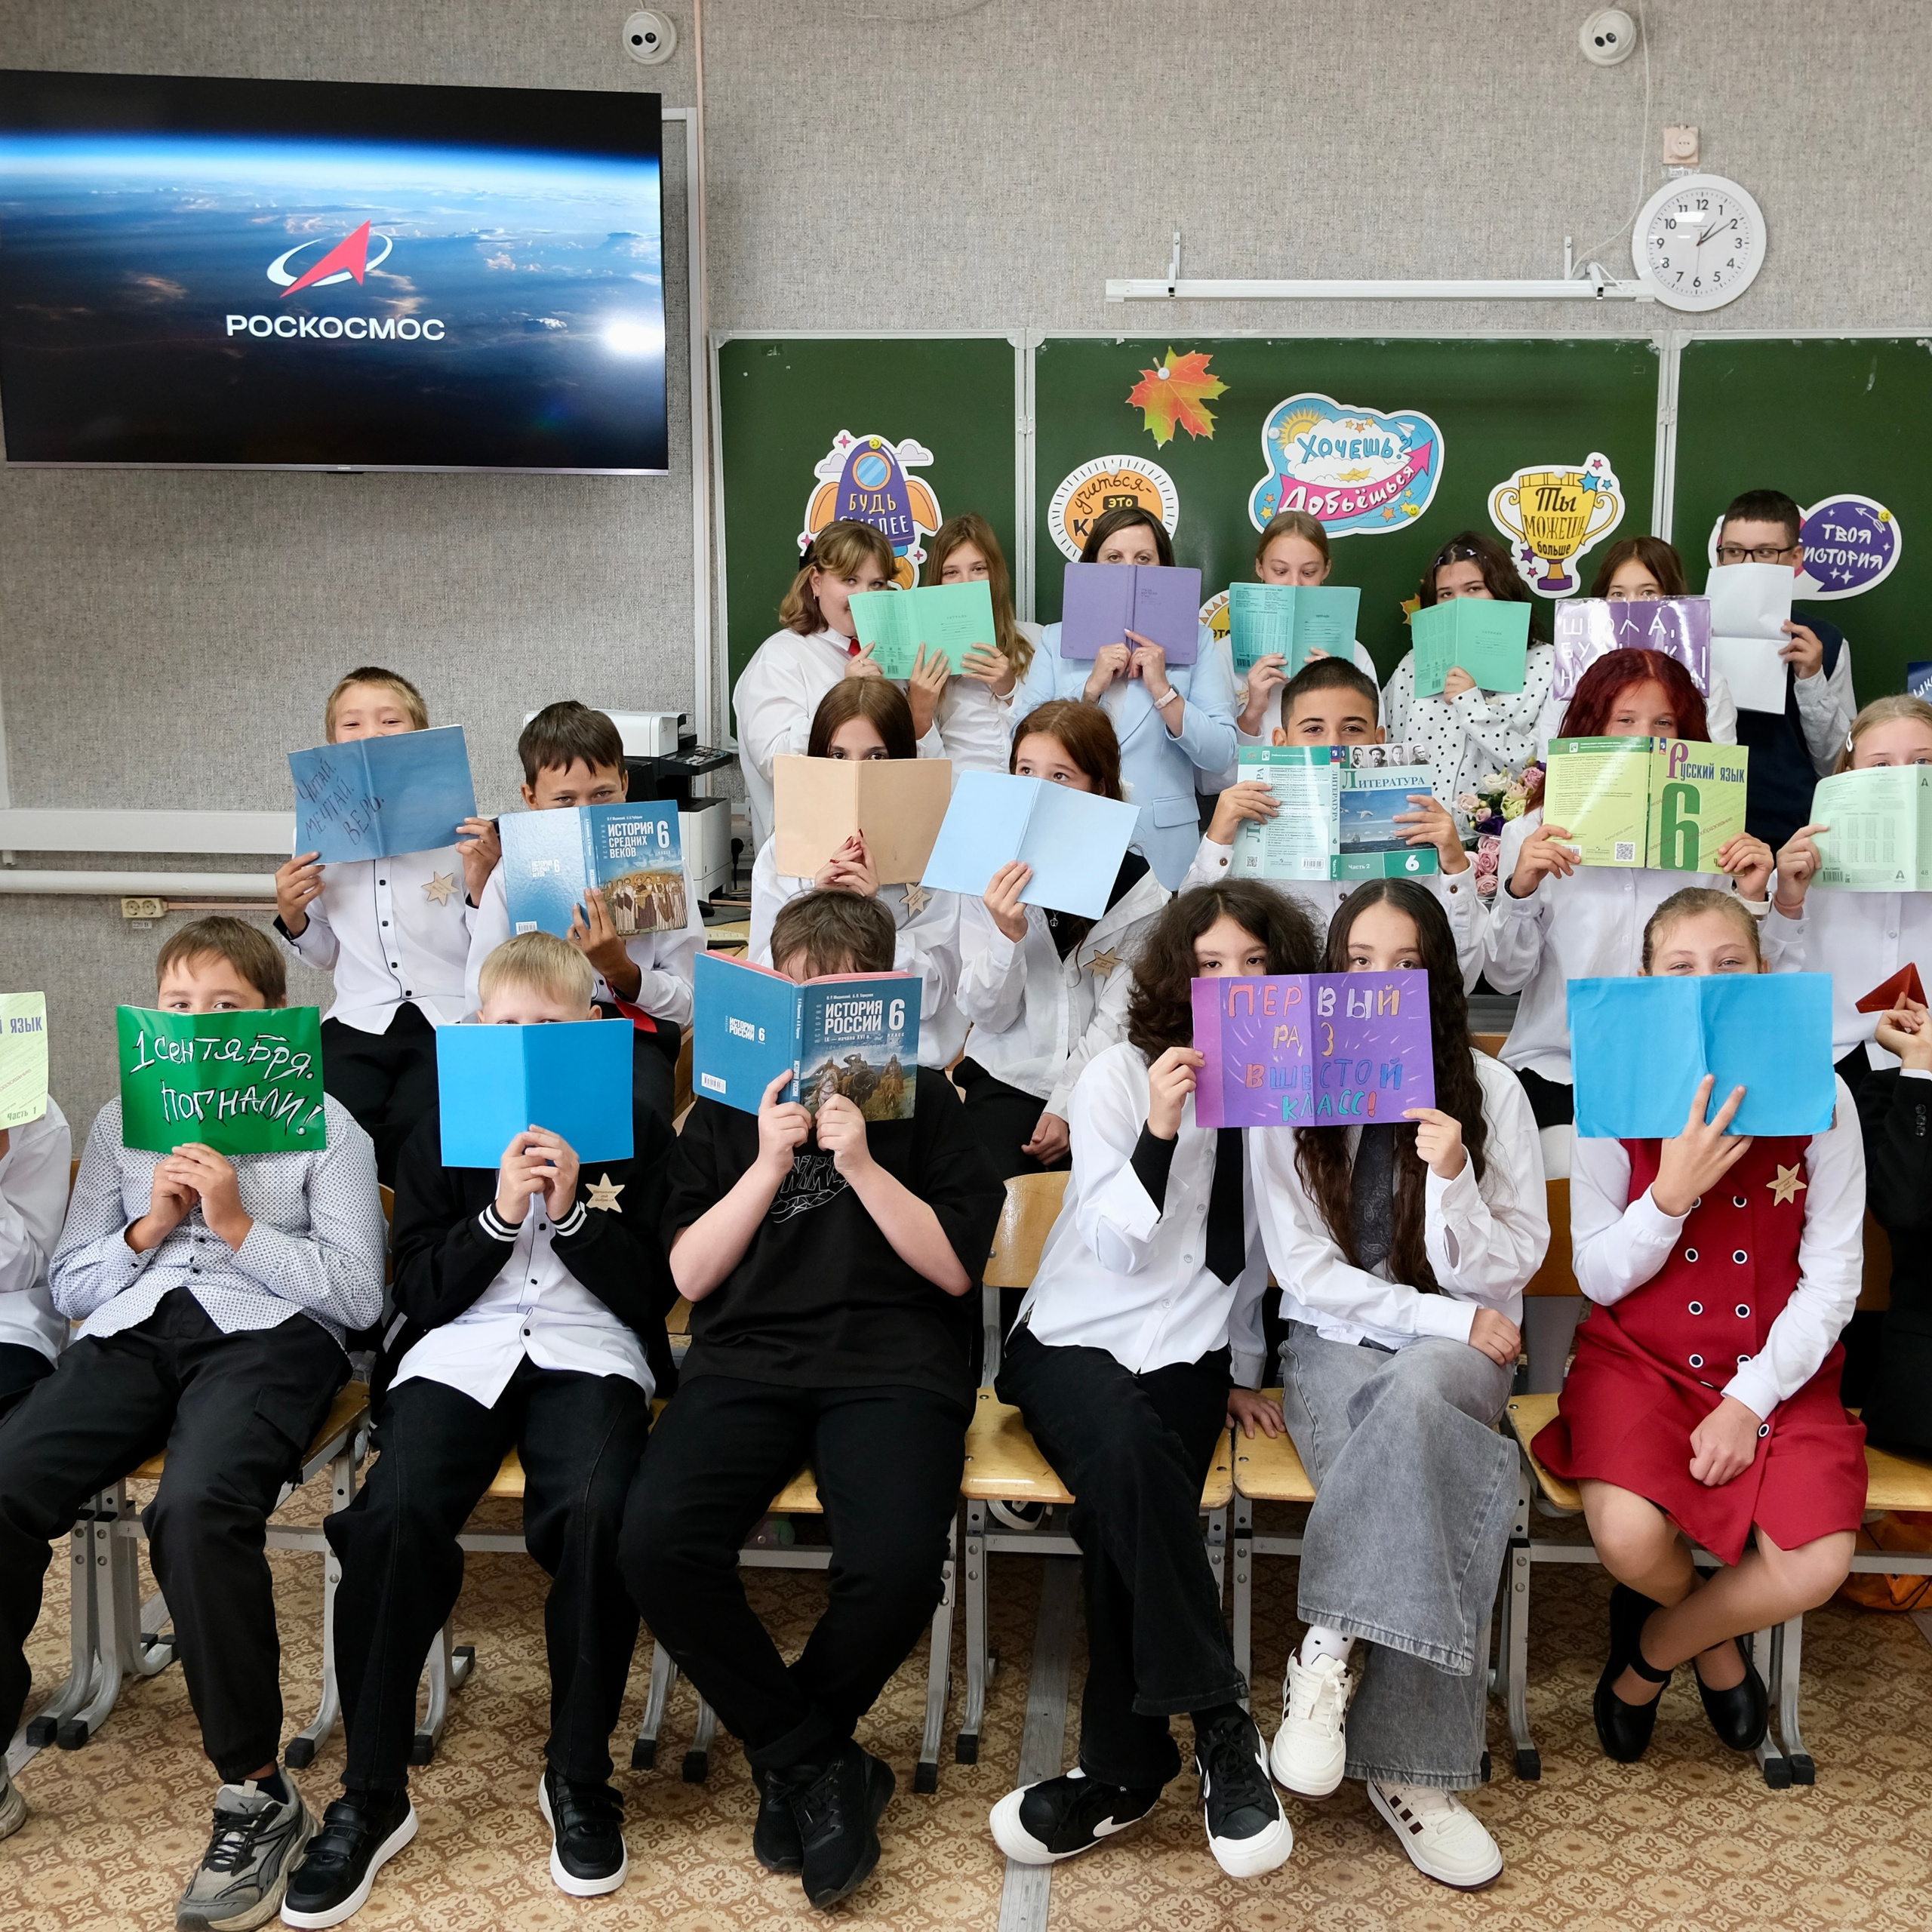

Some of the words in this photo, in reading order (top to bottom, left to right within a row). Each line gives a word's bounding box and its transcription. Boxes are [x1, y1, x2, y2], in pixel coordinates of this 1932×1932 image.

[1678, 205, 1687, 213] 11
[1697, 199, 1709, 211] 12
[1718, 205, 1723, 215] 1
[1664, 218, 1676, 229] 10
[1730, 219, 1738, 229] 2
[1657, 238, 1665, 248] 9
[1734, 238, 1743, 248] 3
[1662, 257, 1669, 268] 8
[1727, 258, 1735, 268] 4
[1676, 272, 1684, 282] 7
[1693, 276, 1701, 288] 6
[1713, 272, 1721, 282] 5
[226, 314, 445, 341] РОСКОСМОС
[1297, 434, 1413, 464] ХОЧЕШЬ?
[1278, 465, 1416, 515] Добьёшься
[848, 493, 898, 515] БУДЬ
[1107, 497, 1134, 509] ЭТО
[1535, 487, 1577, 512] Ты
[839, 515, 910, 536] ЛЕЕ
[1523, 514, 1586, 540] МОЖЕШЬ
[1821, 523, 1872, 545] ТВОЯ
[1537, 540, 1571, 556] больше
[1803, 546, 1884, 571] ИСТОРИЯ
[1666, 742, 1715, 782] Русский
[1720, 767, 1745, 783] язык
[297, 758, 337, 804] ЧИТАЙ.
[1342, 770, 1426, 789] ЛИТЕРАТУРА
[305, 778, 355, 841] МЕЧТАЙ.
[608, 821, 654, 837] ИСТОРИЯ
[657, 820, 670, 849] 6
[1660, 782, 1701, 872] 6
[608, 835, 648, 848] СРЕДНИХ
[609, 847, 637, 859] ВЕКОВ
[553, 859, 560, 873] 6
[1405, 854, 1420, 872] 6
[826, 999, 883, 1019] ИСТОРИЯ
[1227, 983, 1401, 1021] ПЕРВЫЙ
[888, 998, 906, 1031] 6
[10, 1016, 43, 1034] язык
[729, 1016, 755, 1032] ИСТОРИЯ
[729, 1025, 755, 1041] РОССИИ
[814, 1004, 823, 1044] ИСТОРИЯ
[824, 1014, 882, 1035] РОССИИ
[758, 1027, 765, 1041] 6
[128, 1029, 155, 1077] 1
[7, 1109, 29, 1121] Часть
[32, 1106, 36, 1115] 1
[1281, 1088, 1377, 1122] КЛАСС!
